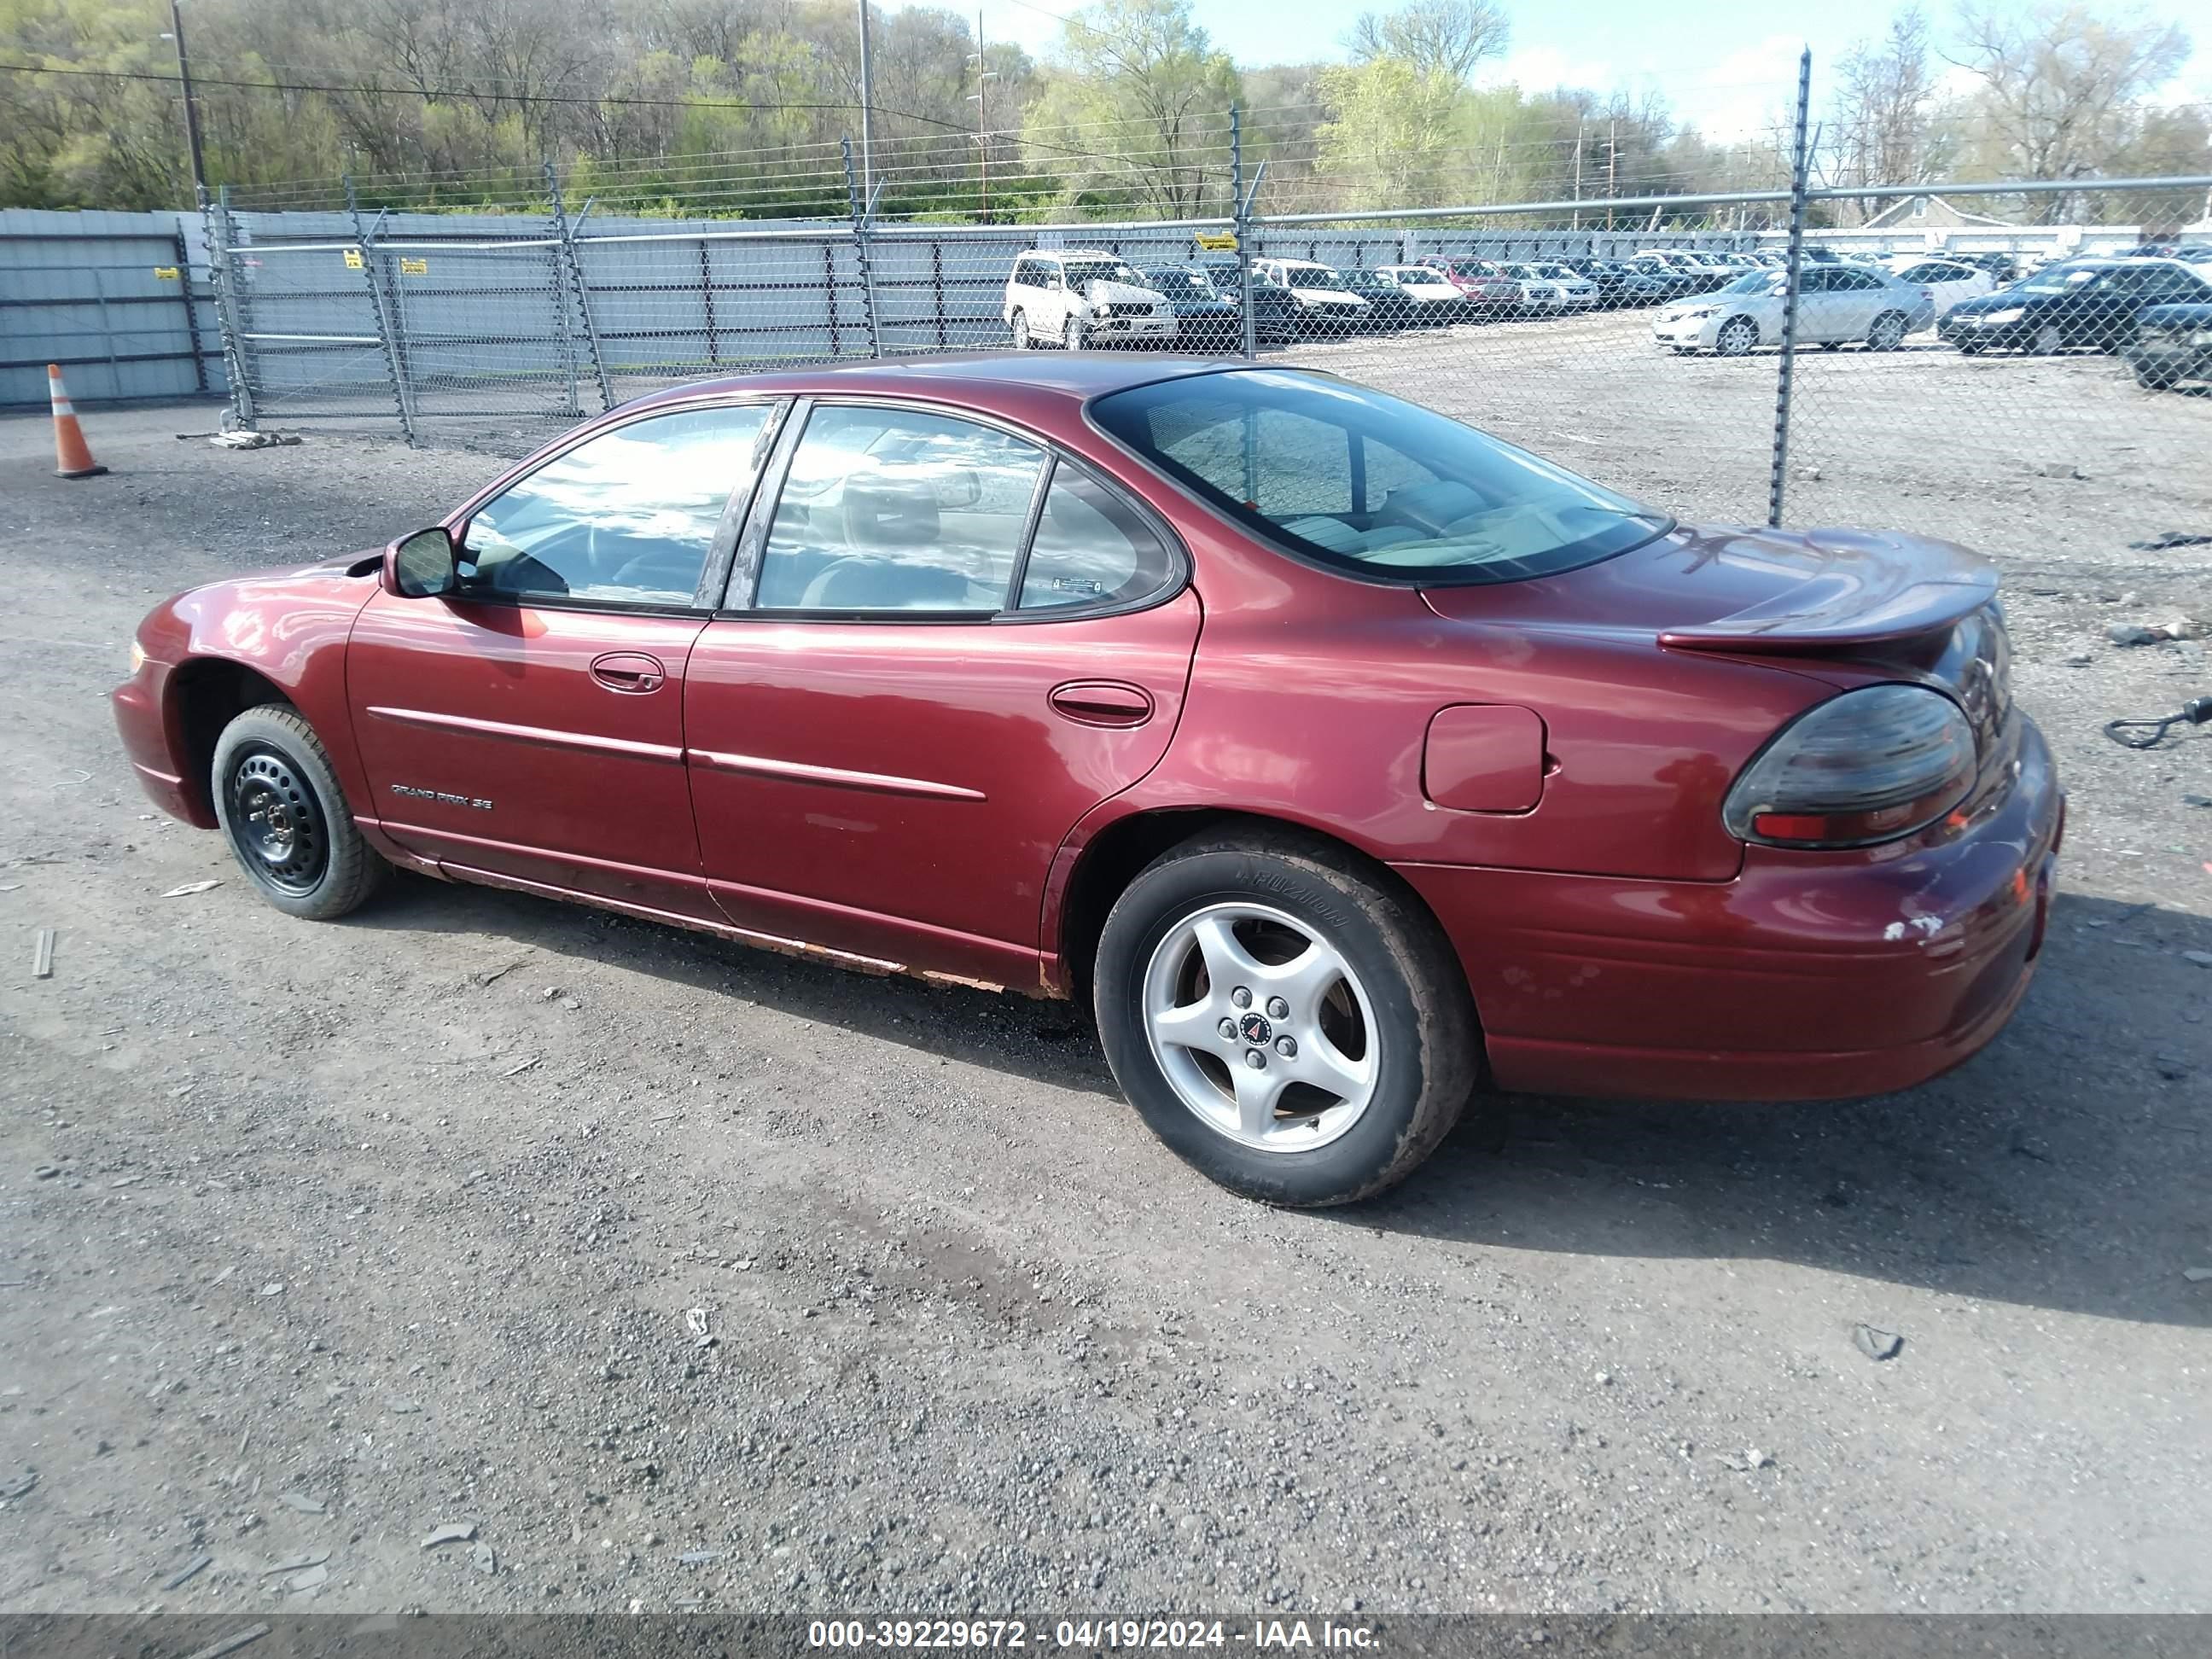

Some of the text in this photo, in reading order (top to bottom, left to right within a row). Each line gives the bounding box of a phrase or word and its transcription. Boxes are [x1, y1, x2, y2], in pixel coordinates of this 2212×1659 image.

[390, 783, 493, 810] GRAND PRIX SE
[1243, 1014, 1271, 1037] PONTIAC
